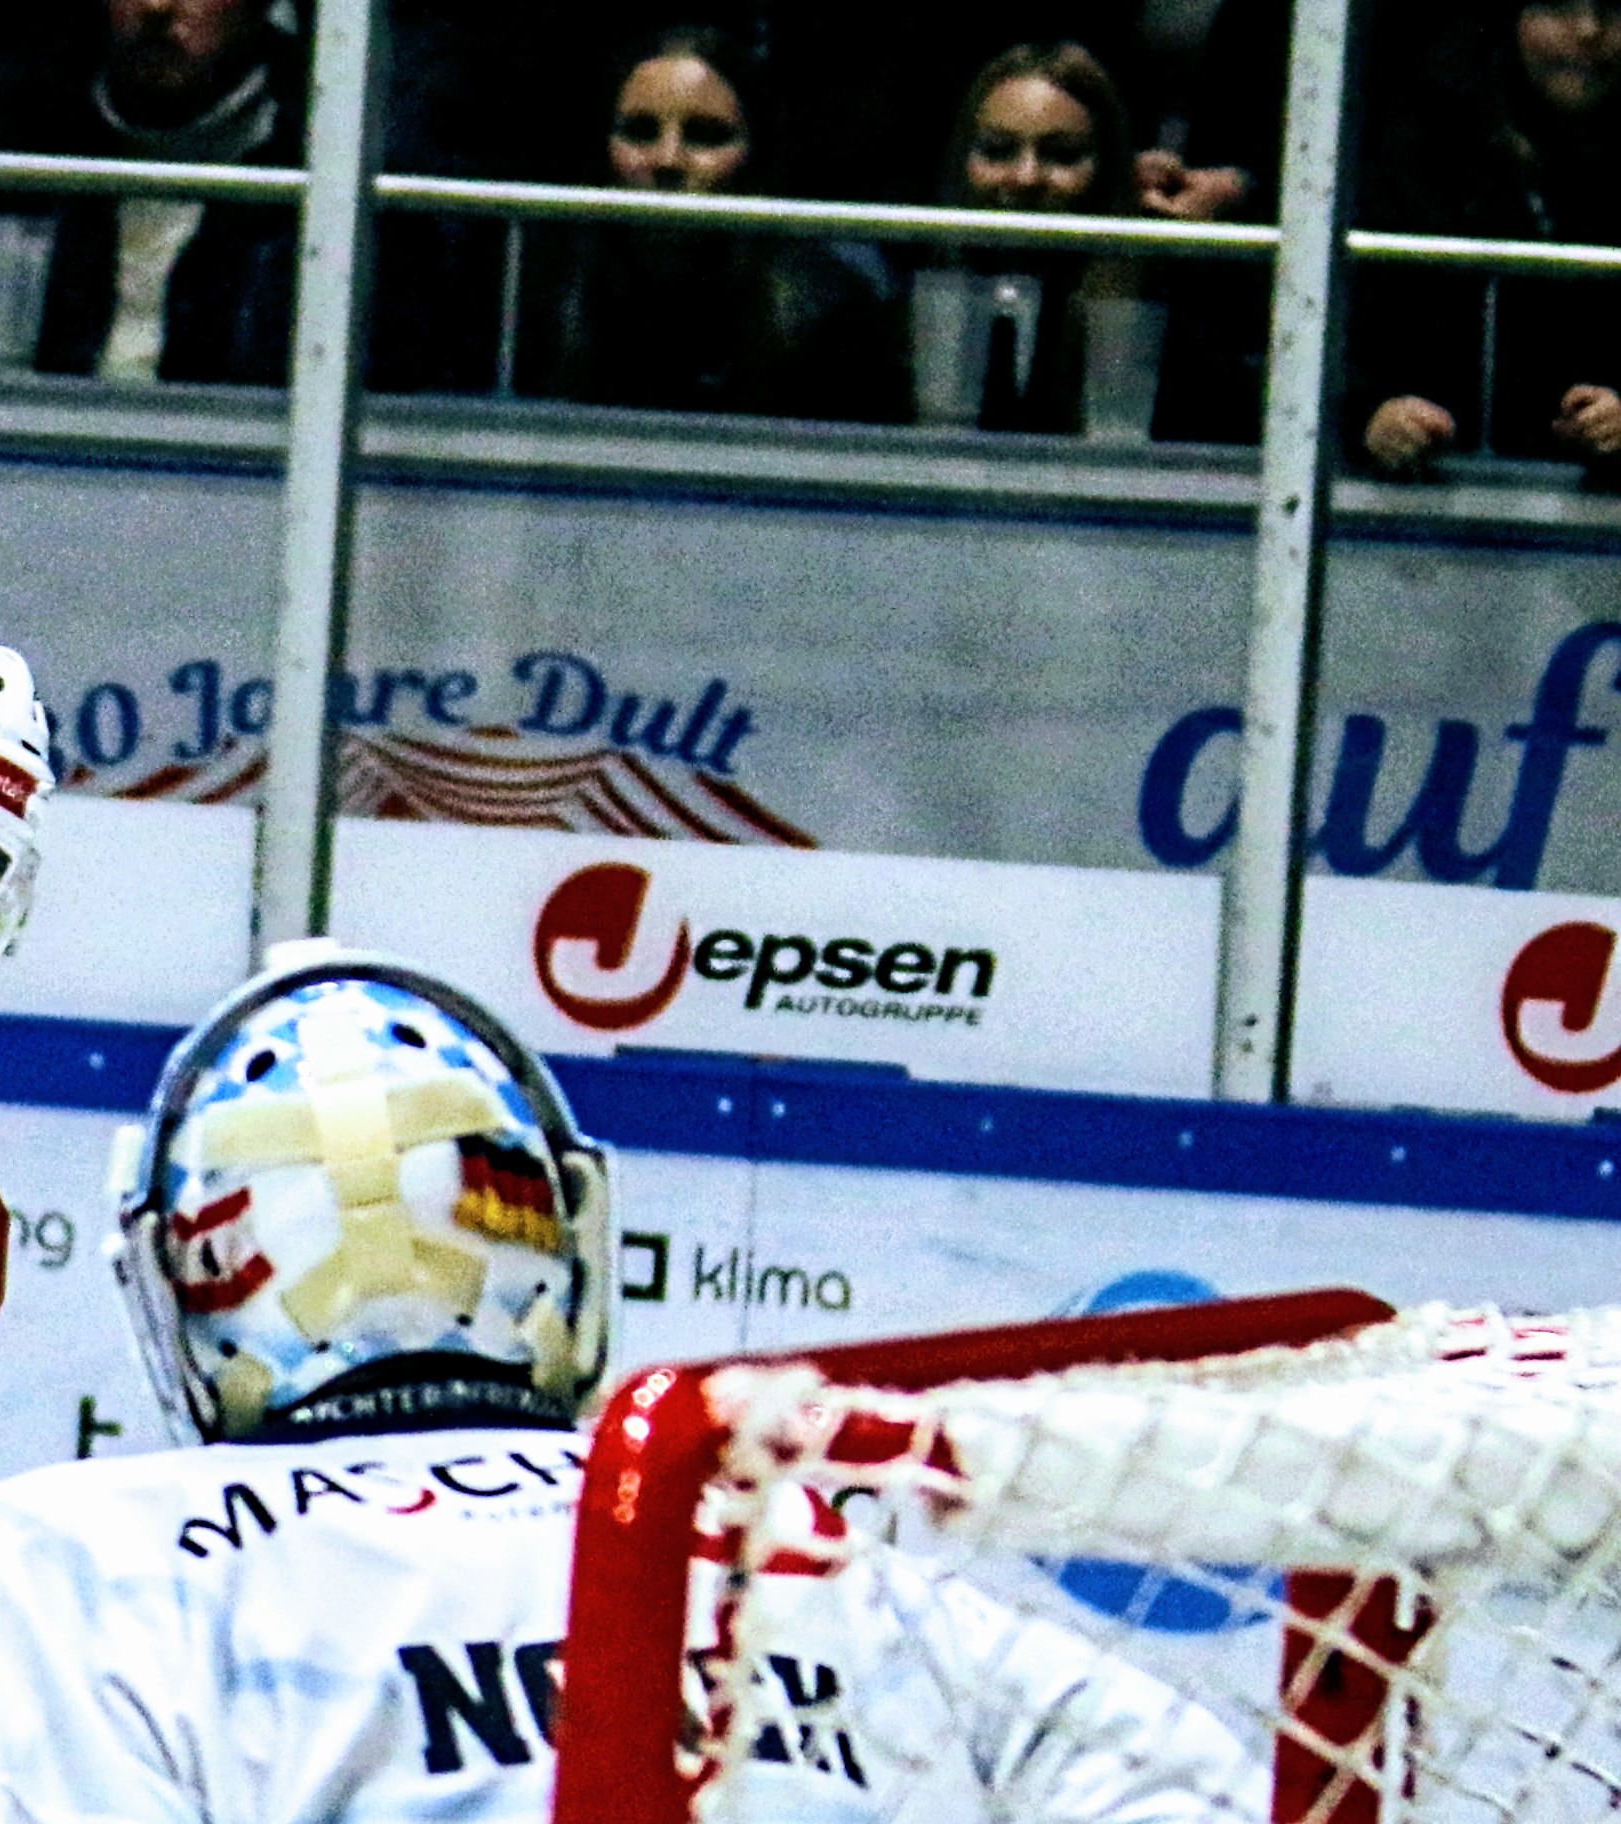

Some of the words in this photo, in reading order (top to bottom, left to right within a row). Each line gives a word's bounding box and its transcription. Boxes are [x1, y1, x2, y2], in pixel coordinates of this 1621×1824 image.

[513, 647, 761, 775] Dult
[774, 994, 983, 1027] AUTOGRUPPE
[691, 1244, 855, 1313] klima
